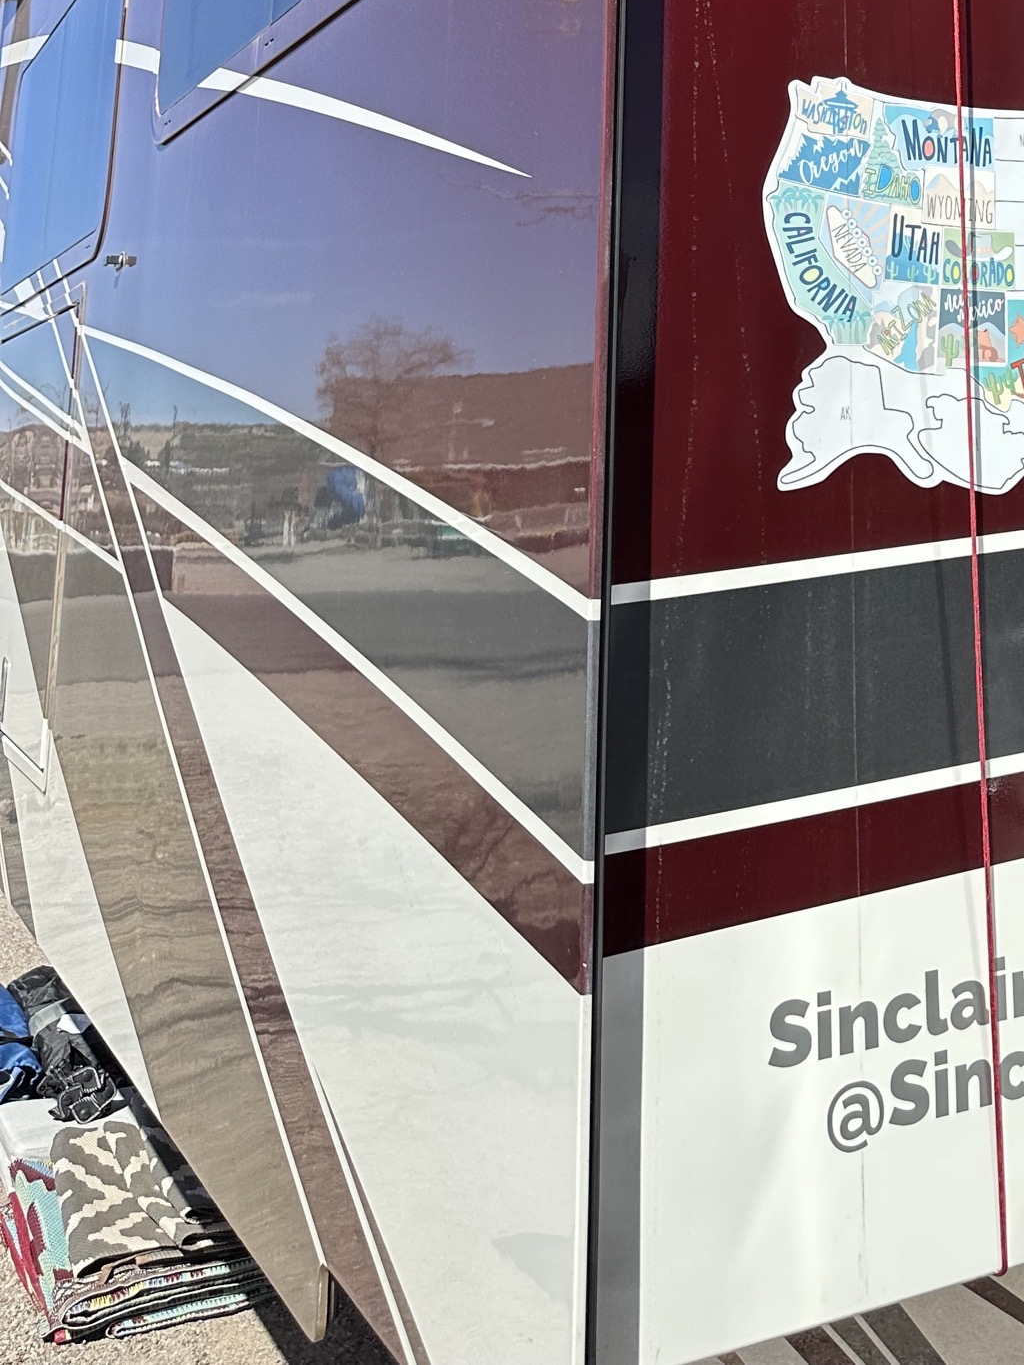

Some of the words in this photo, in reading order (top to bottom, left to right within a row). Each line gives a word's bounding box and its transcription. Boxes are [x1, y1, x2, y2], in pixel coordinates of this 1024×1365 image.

[797, 138, 864, 185] Oregon
[901, 119, 992, 167] MONTANA
[862, 164, 921, 205] IDAHO
[831, 223, 868, 274] NEVADA
[891, 213, 940, 265] UTAH
[782, 212, 857, 323] CALIFORNIA
[943, 257, 1015, 287] COORADO
[840, 406, 851, 421] AK
